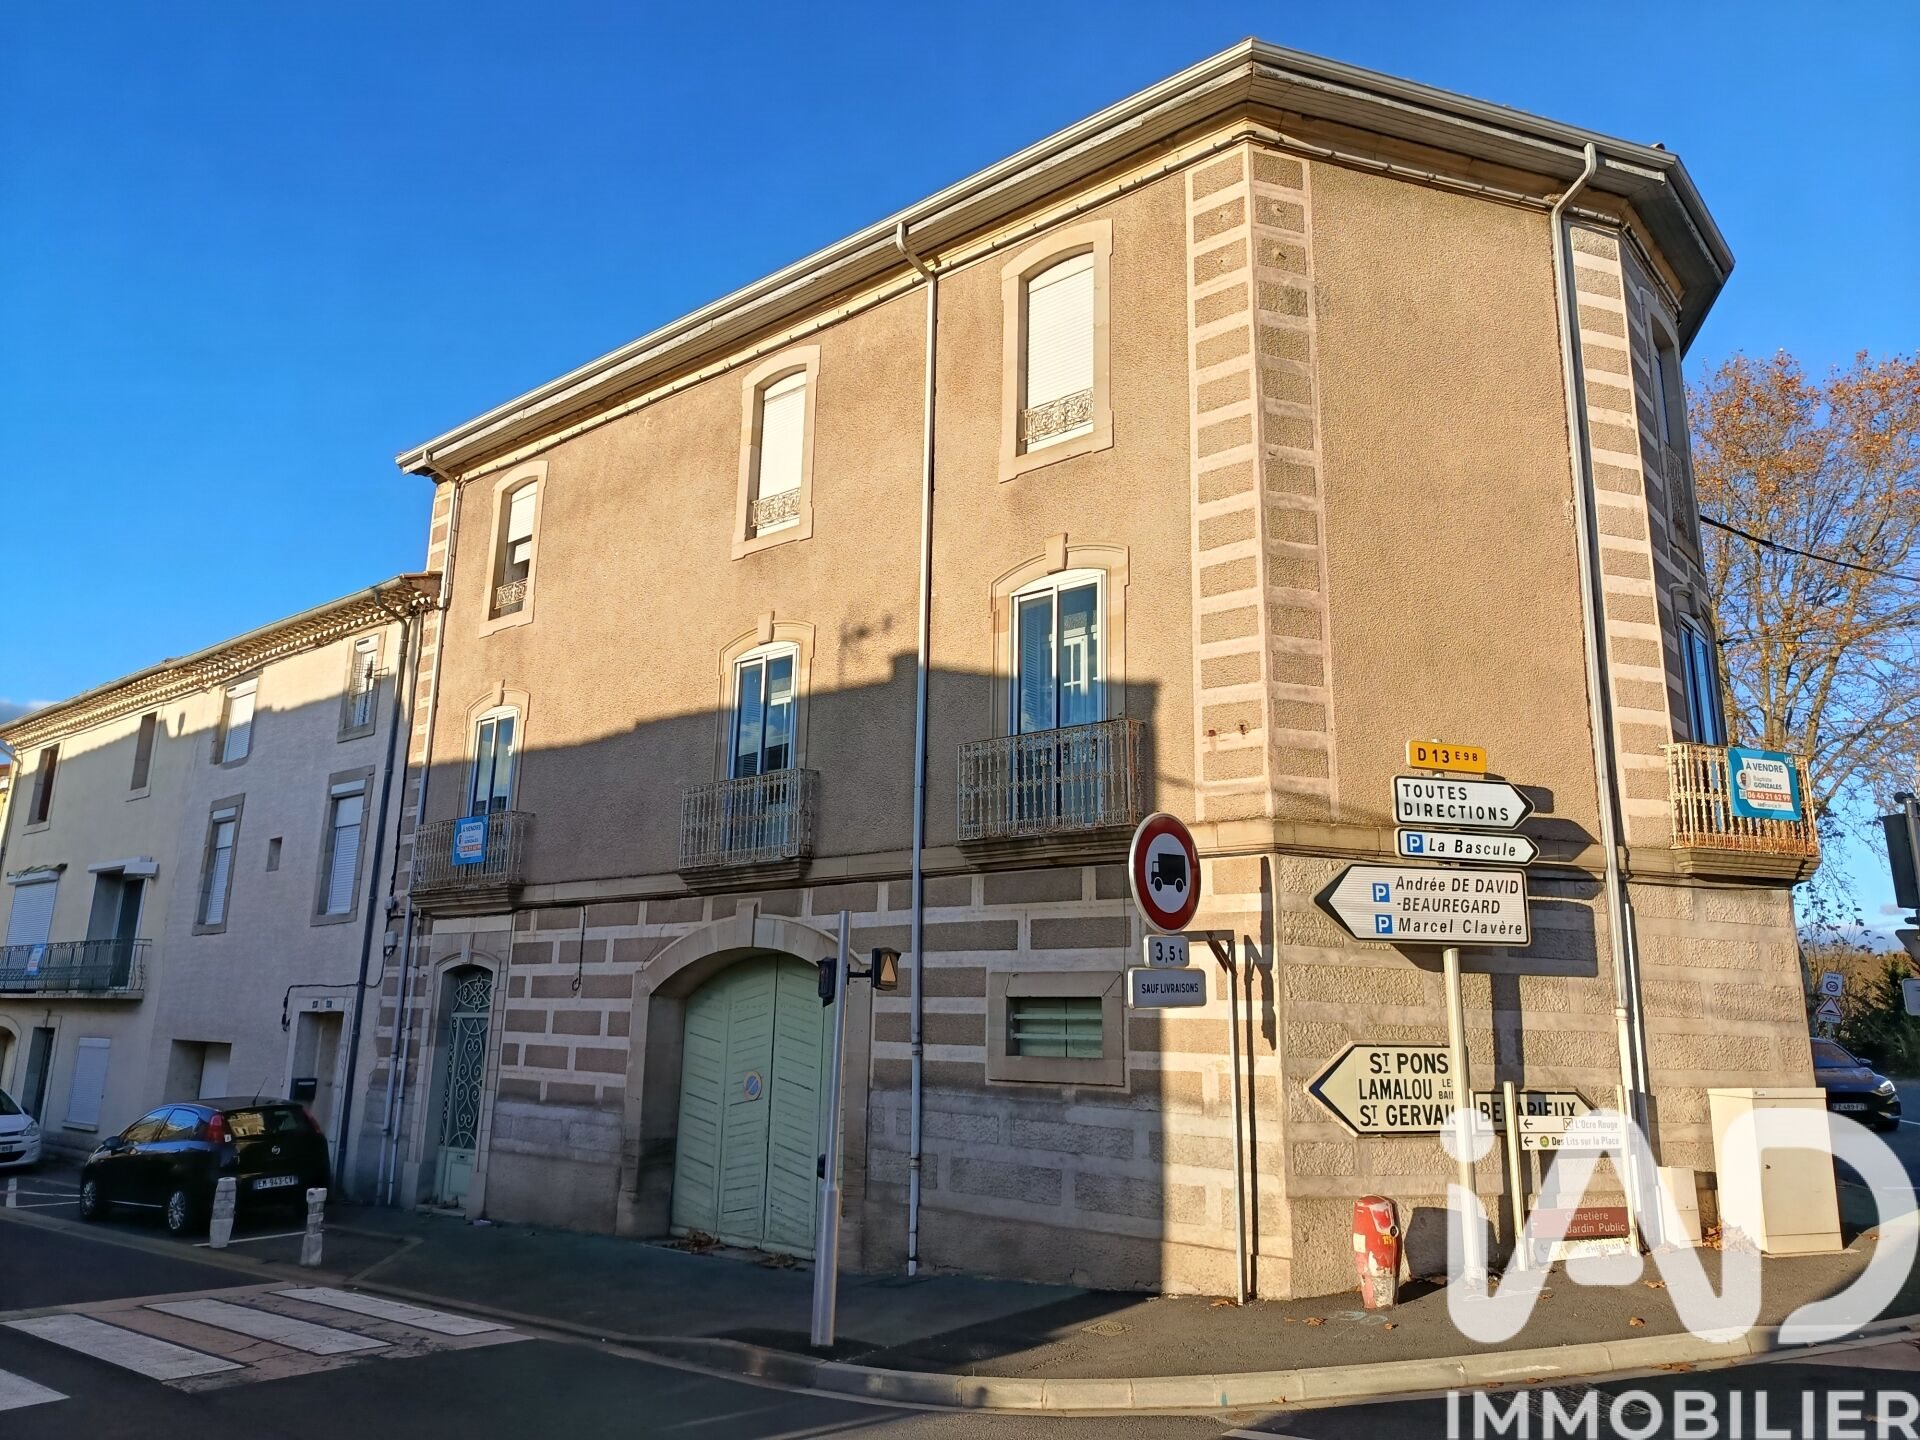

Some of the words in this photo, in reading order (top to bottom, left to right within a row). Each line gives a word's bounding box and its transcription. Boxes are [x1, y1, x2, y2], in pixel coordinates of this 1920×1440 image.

[1753, 763, 1784, 773] VENDRE
[1402, 783, 1468, 800] TOUTES
[1404, 802, 1509, 821] DIRECTIONS
[1429, 837, 1445, 852] La
[1455, 839, 1516, 857] Bascule
[1395, 876, 1446, 892] Andrée
[1452, 878, 1470, 892] DE
[1475, 879, 1519, 894] DAVID
[1397, 897, 1500, 914] -BEAUREGARD
[1399, 918, 1453, 933] Marcel
[1463, 919, 1522, 936] Clavère
[1142, 984, 1159, 993] SAUF
[1161, 983, 1198, 993] LIVRAISONS
[1397, 1053, 1449, 1074] PONS
[1359, 1079, 1432, 1100] LAMALOU
[1442, 1079, 1453, 1087] LE
[1552, 1137, 1564, 1145] Des
[1566, 1136, 1579, 1145] Lits
[1567, 1224, 1594, 1233] Jardin
[1598, 1222, 1626, 1232] Public
